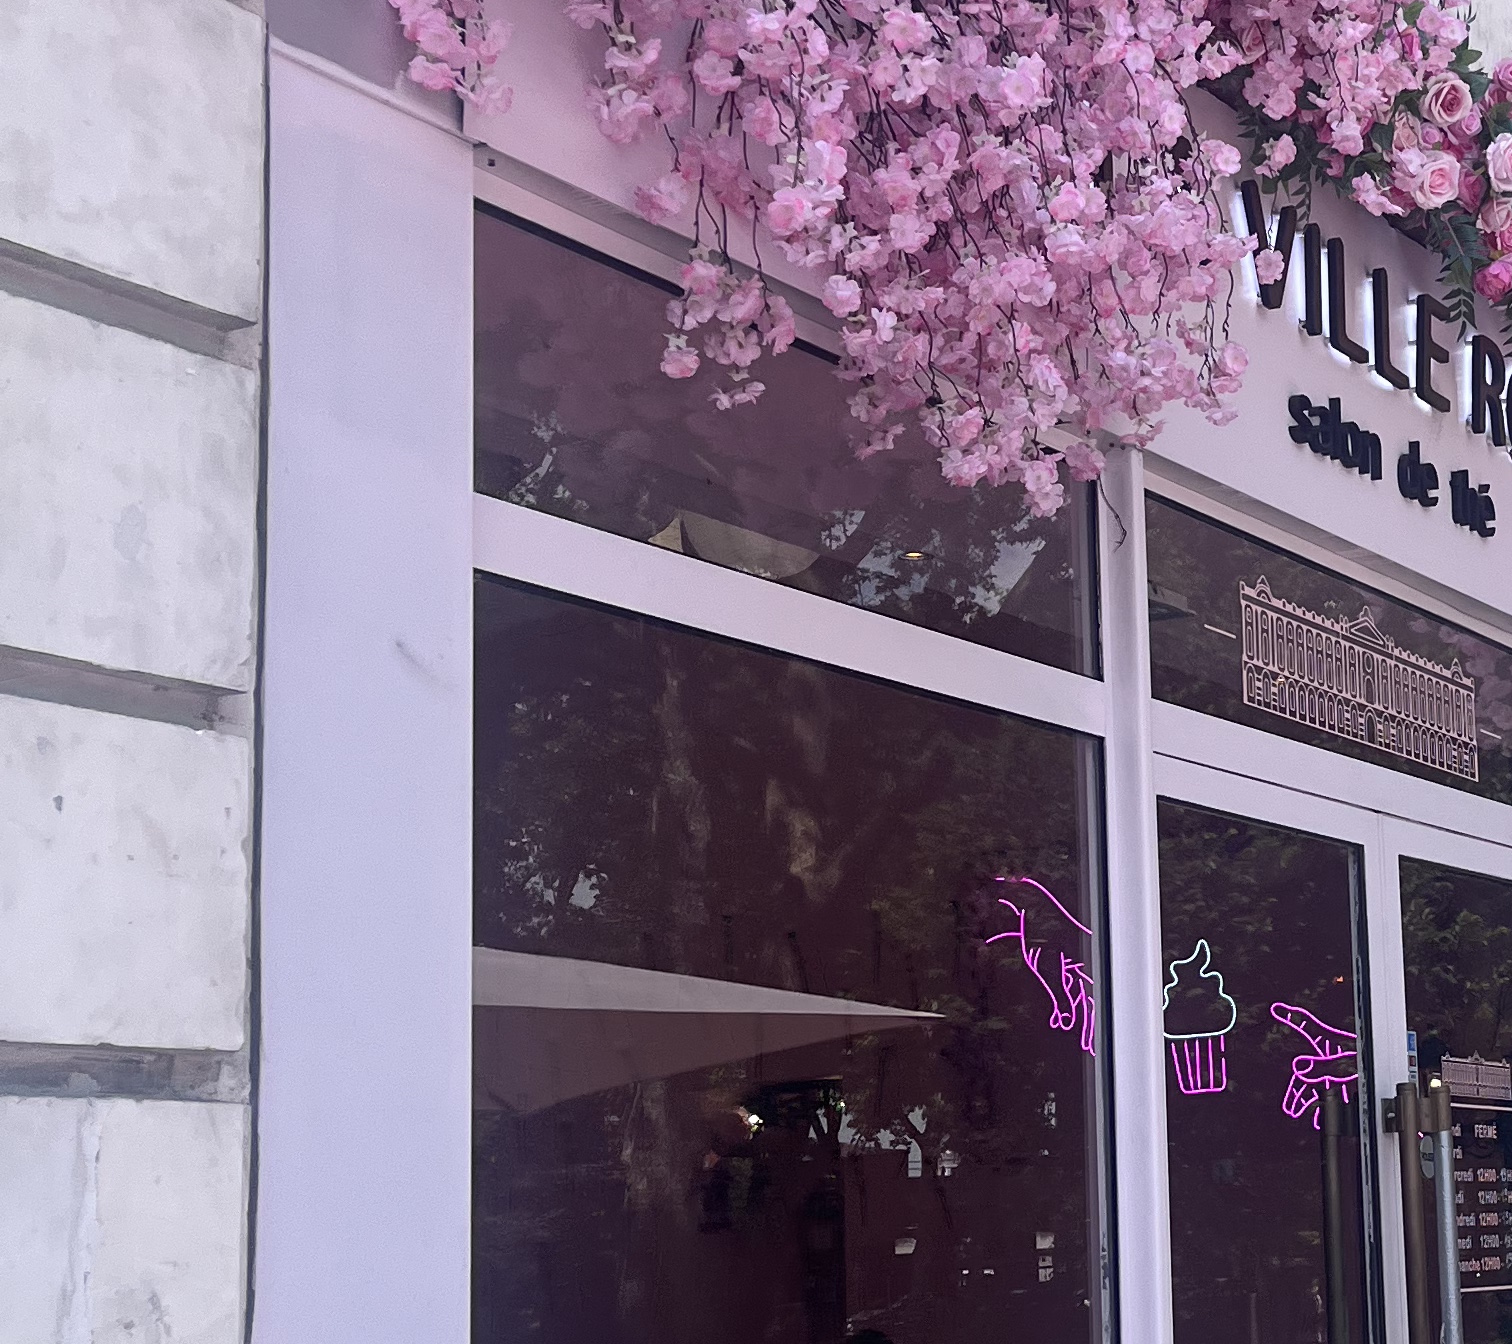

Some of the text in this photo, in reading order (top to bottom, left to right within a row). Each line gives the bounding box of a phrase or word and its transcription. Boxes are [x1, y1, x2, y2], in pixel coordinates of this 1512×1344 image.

[1240, 179, 1451, 413] VILLE
[1397, 440, 1440, 508] de
[1449, 469, 1497, 538] thé
[1454, 1168, 1474, 1182] rcredi
